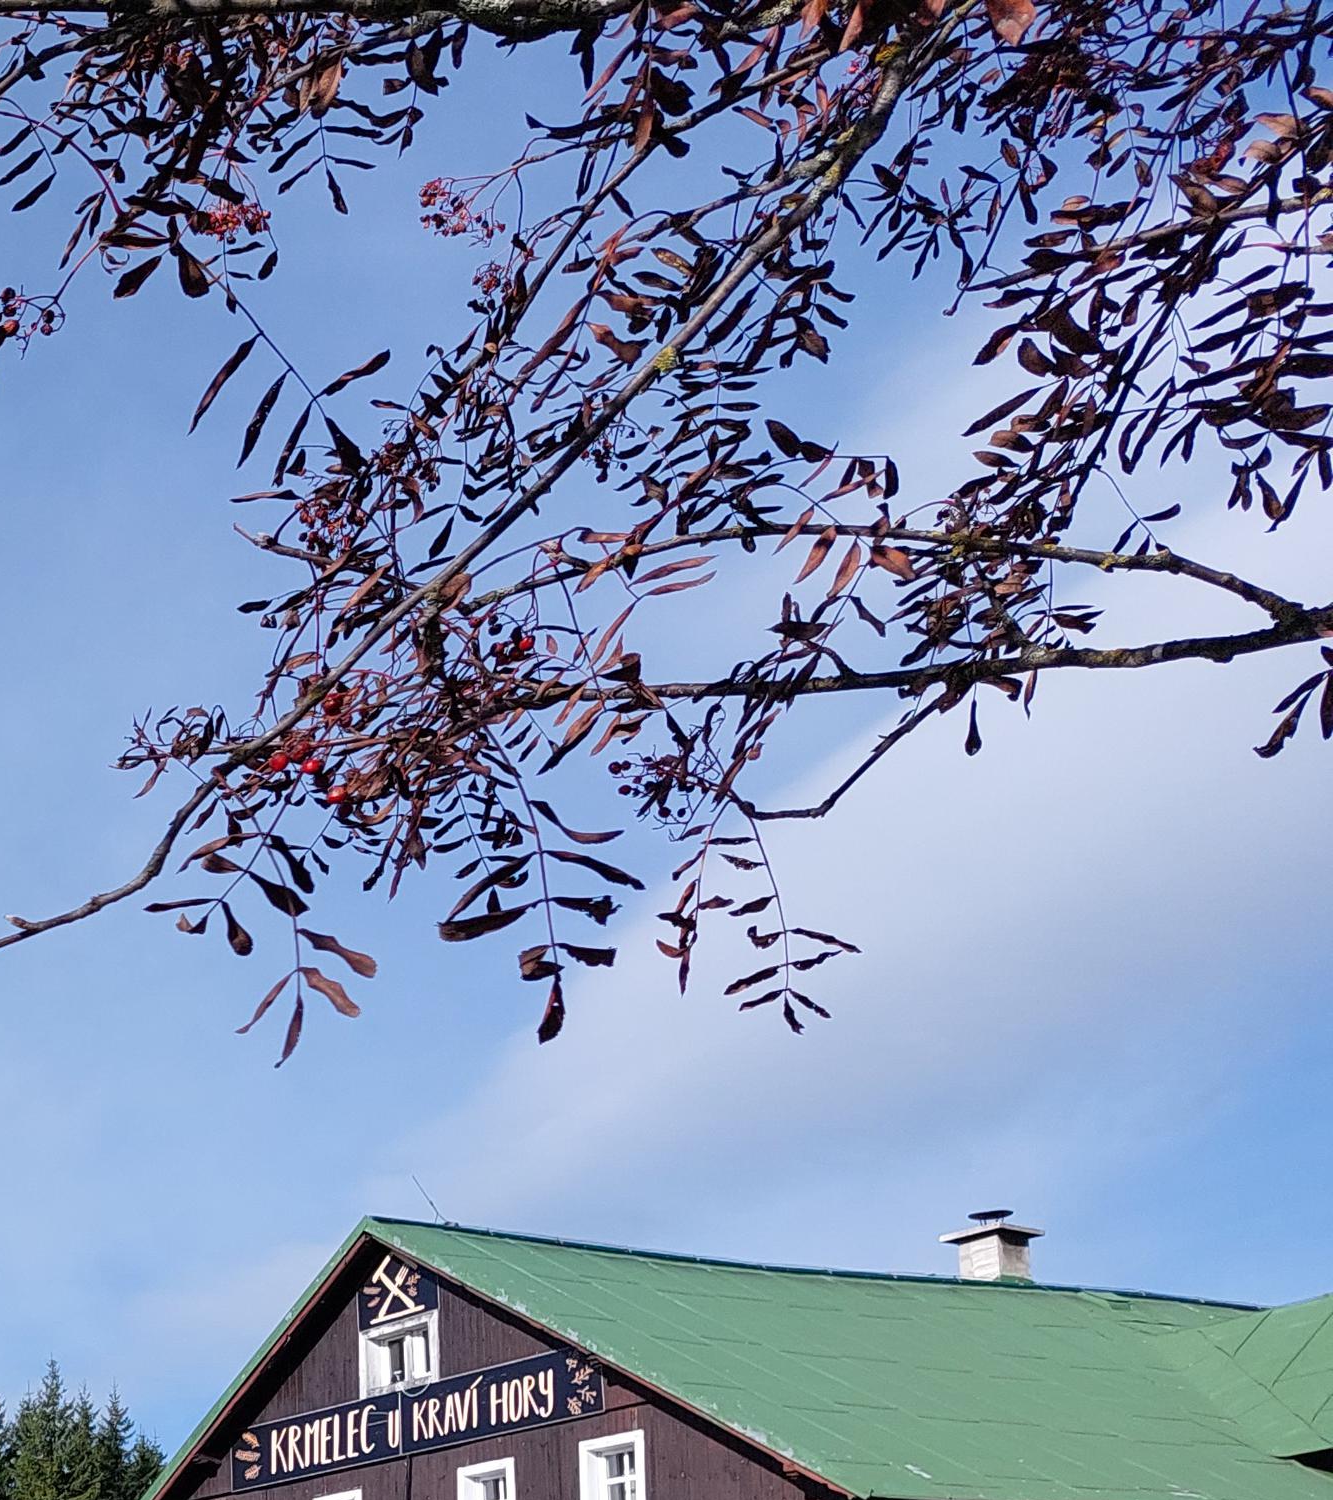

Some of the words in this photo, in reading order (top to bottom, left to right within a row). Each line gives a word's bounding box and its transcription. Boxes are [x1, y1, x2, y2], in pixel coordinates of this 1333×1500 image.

[270, 1404, 375, 1475] KRMELEC
[412, 1375, 483, 1442] KRAVÍ
[489, 1368, 554, 1426] HORY
